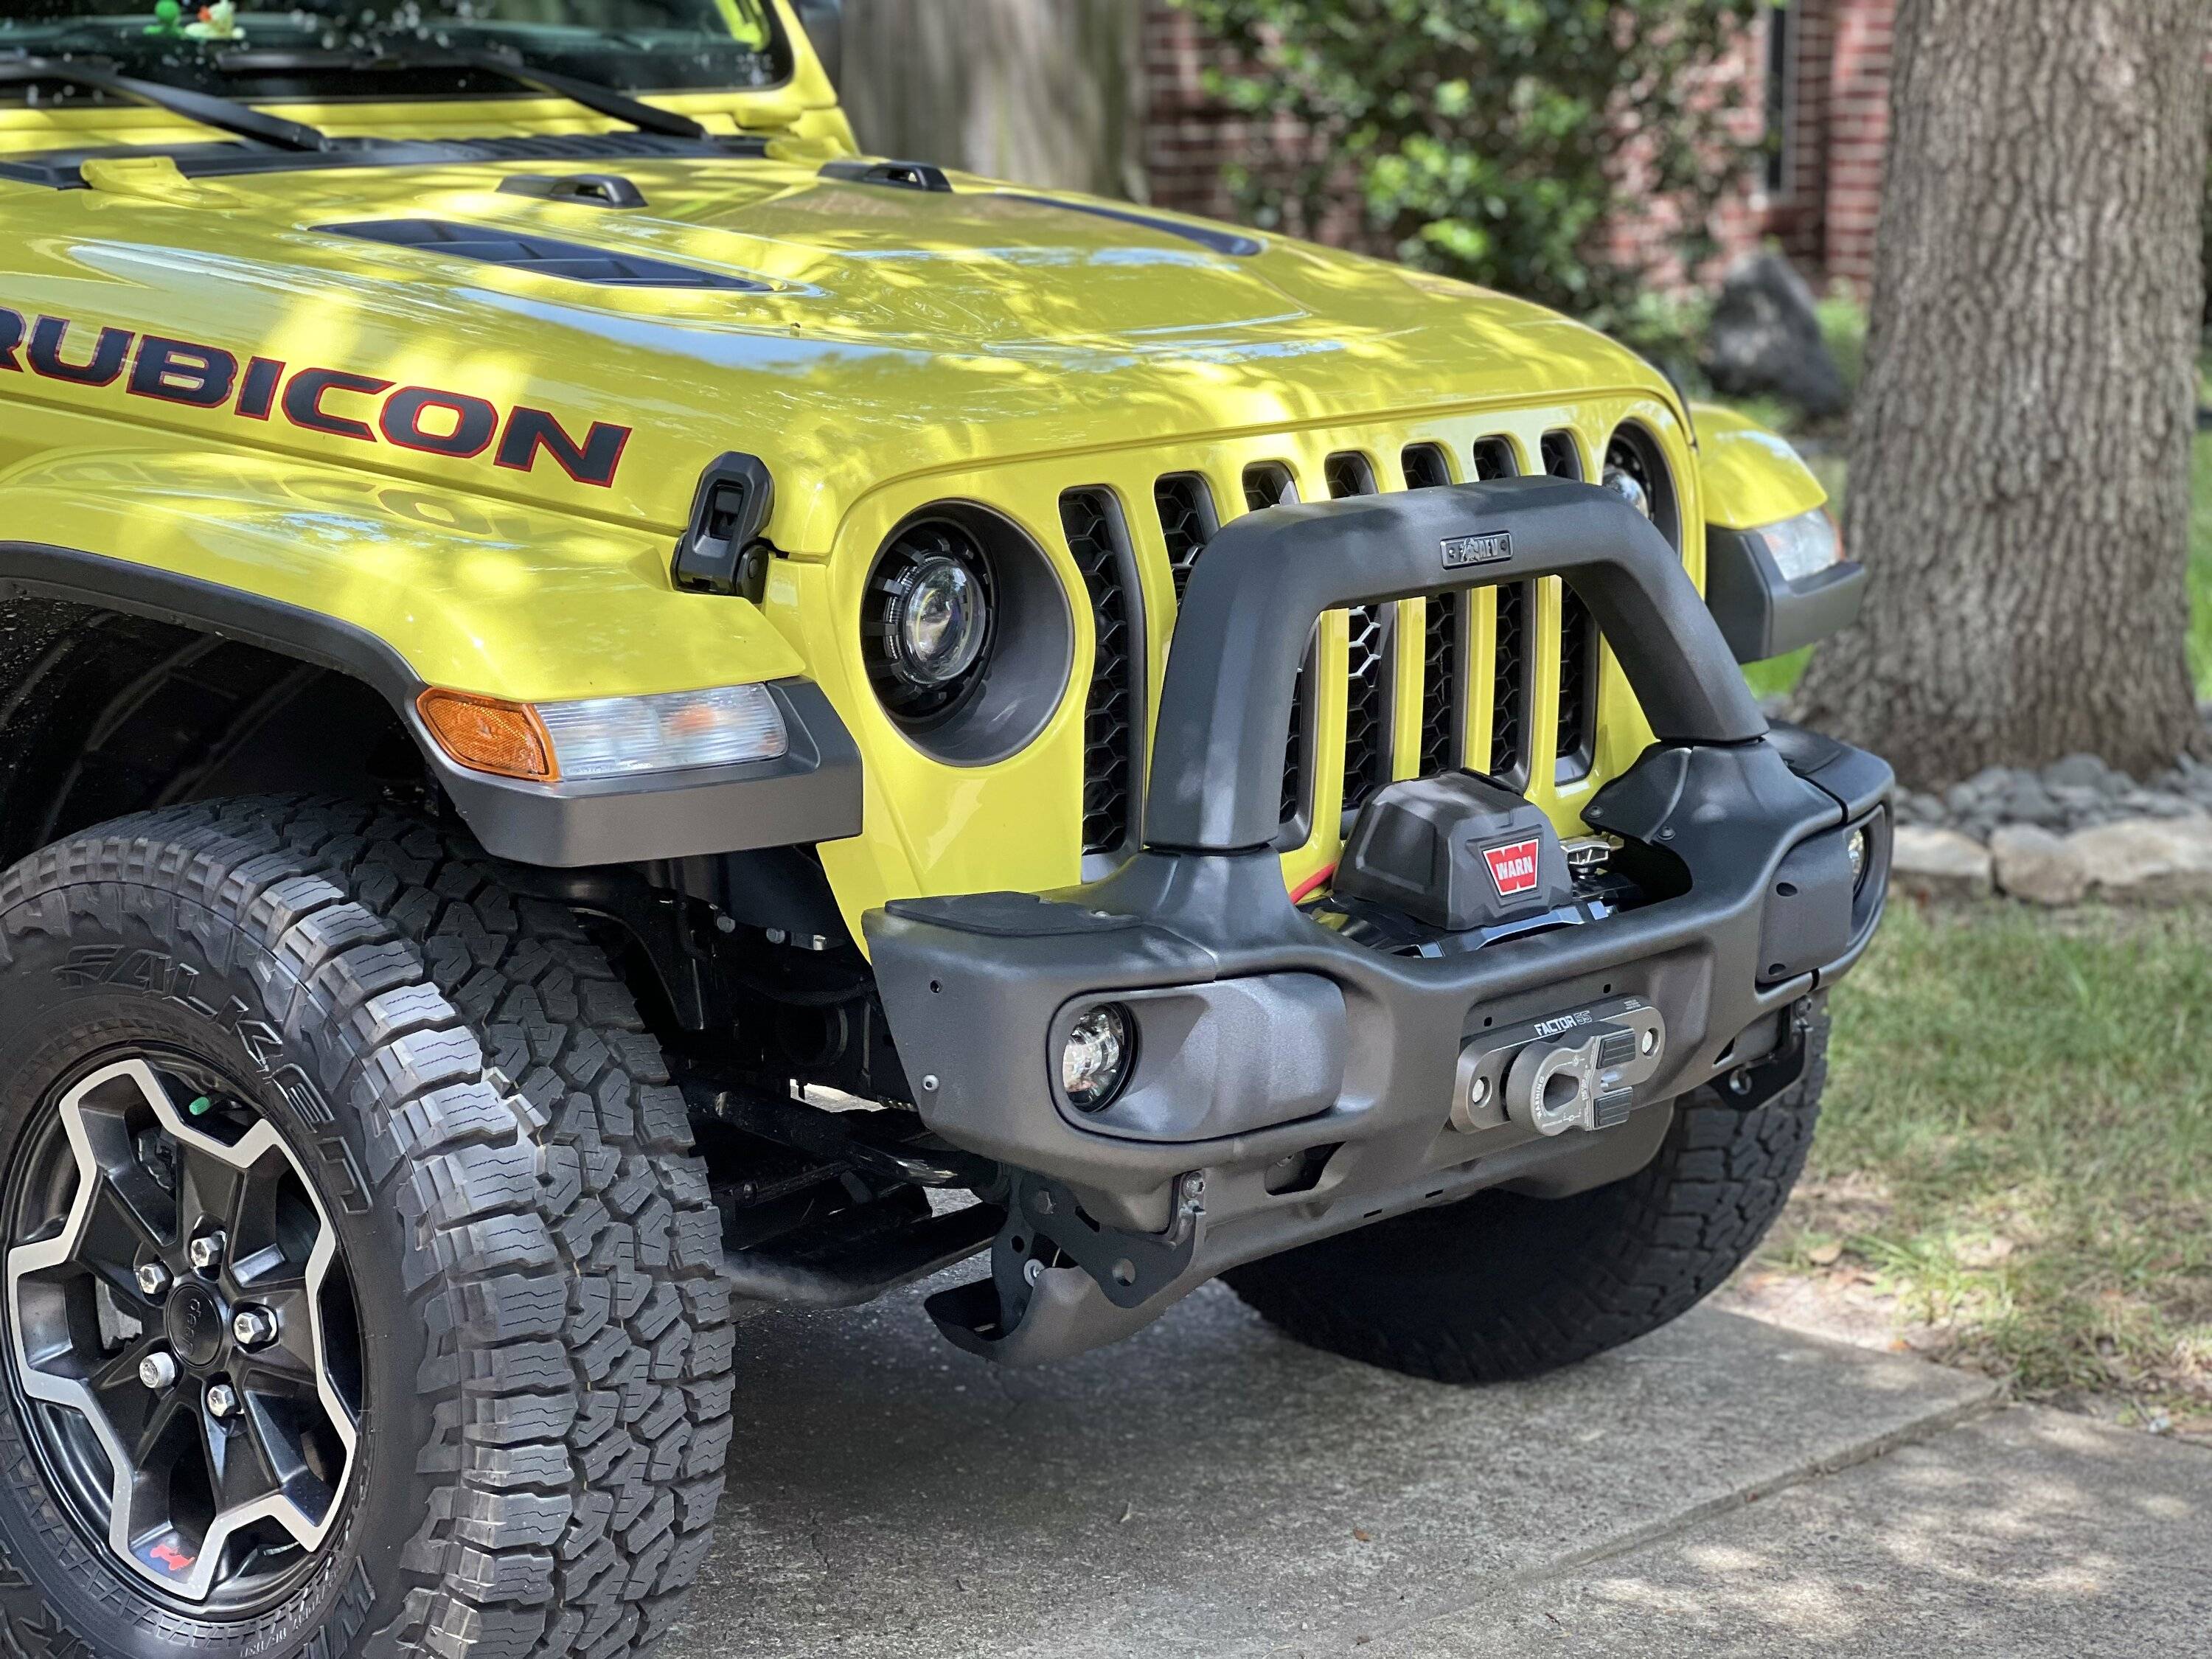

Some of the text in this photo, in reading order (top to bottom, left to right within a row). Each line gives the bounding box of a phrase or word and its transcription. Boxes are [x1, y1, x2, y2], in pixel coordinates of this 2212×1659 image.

[1495, 856, 1534, 880] WARN
[1534, 1015, 1577, 1036] FACTOR
[51, 945, 373, 1214] FALKEN
[1534, 1076, 1545, 1120] WARNING
[180, 1298, 202, 1357] Jeep
